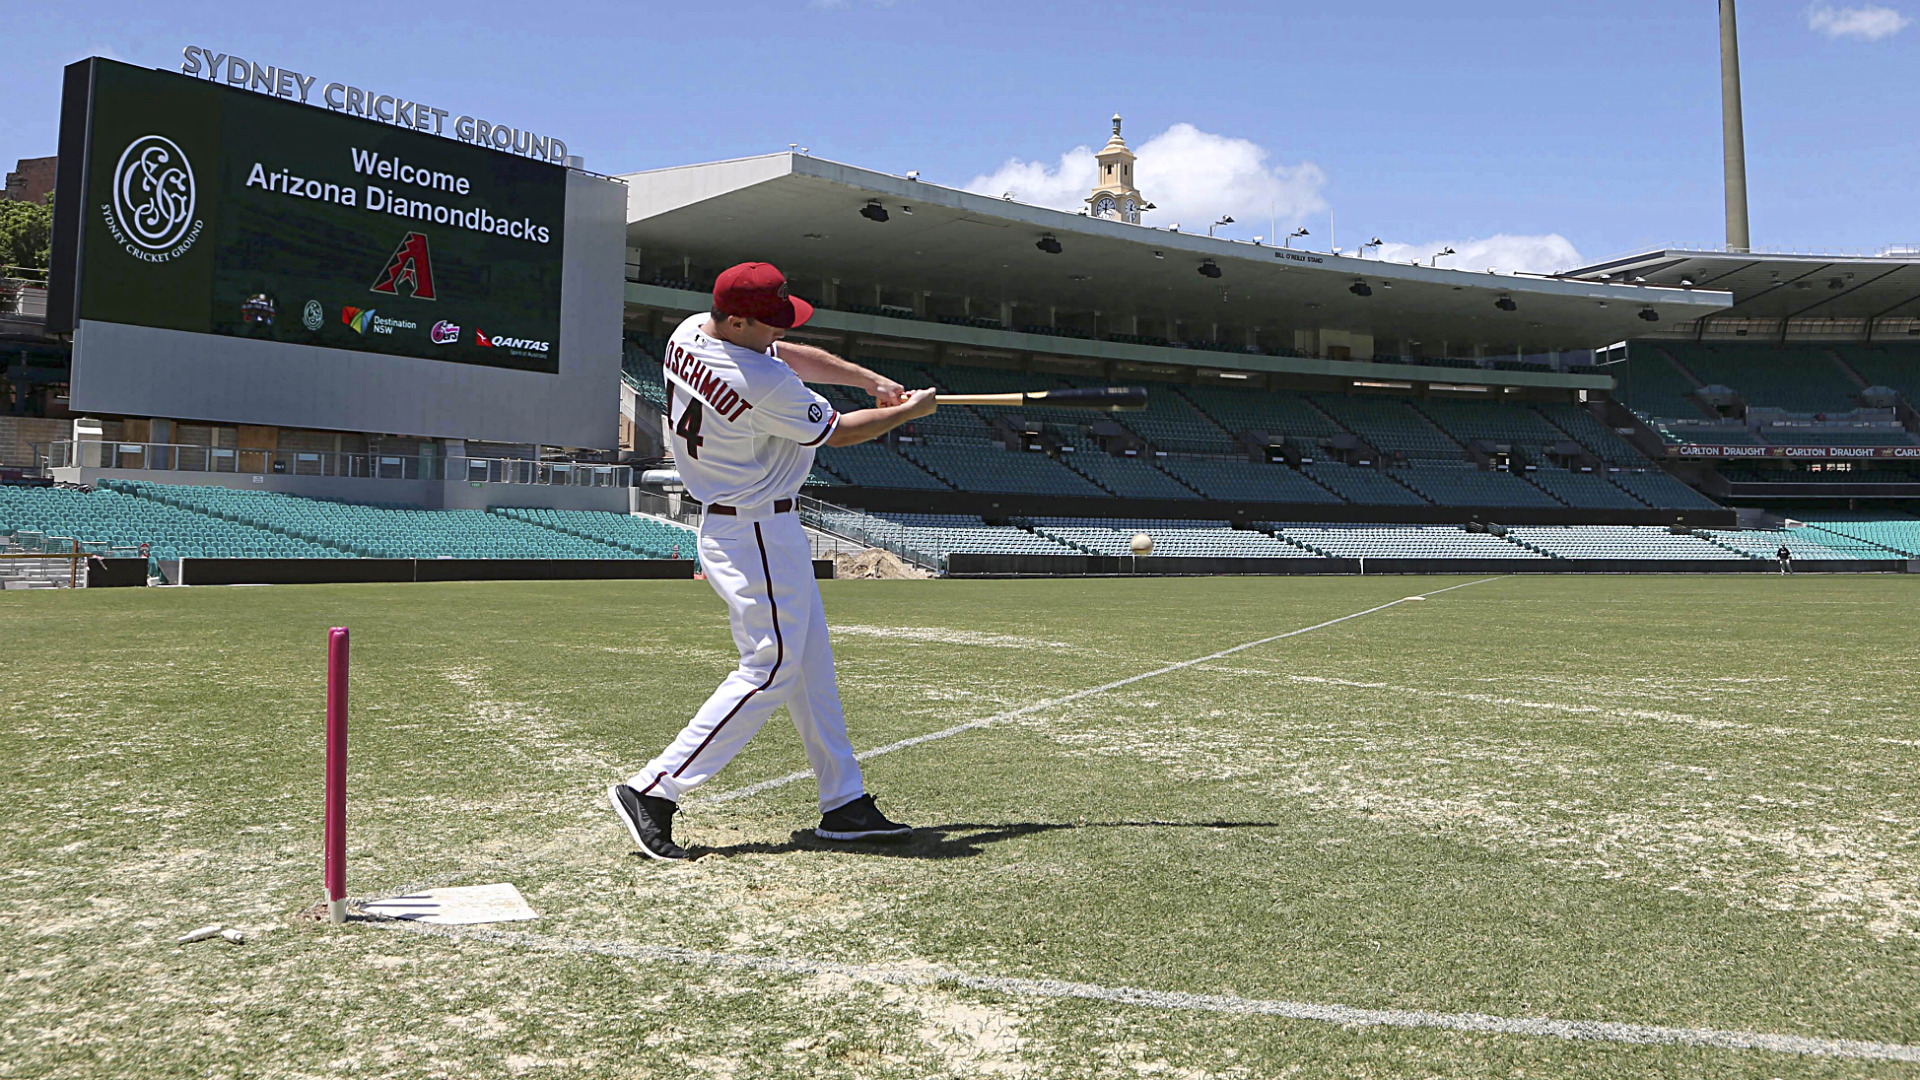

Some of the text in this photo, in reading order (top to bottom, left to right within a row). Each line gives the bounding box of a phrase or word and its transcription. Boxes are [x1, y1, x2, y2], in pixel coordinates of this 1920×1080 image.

[180, 45, 568, 162] SYDNEY CRICKET GROUND
[351, 147, 470, 195] Welcome
[245, 162, 551, 244] Arizona Diamondbacks
[101, 204, 204, 263] SYDNEY CRICKET GROUND
[373, 315, 417, 330] Destination
[373, 324, 394, 335] NSW
[491, 335, 550, 352] QANTAS
[809, 405, 821, 421] 19
[1680, 446, 1720, 456] CARLTON
[1723, 446, 1767, 456] DRAUGHT
[1785, 447, 1826, 457] CARLTON
[1829, 447, 1875, 457] DRAUGHT
